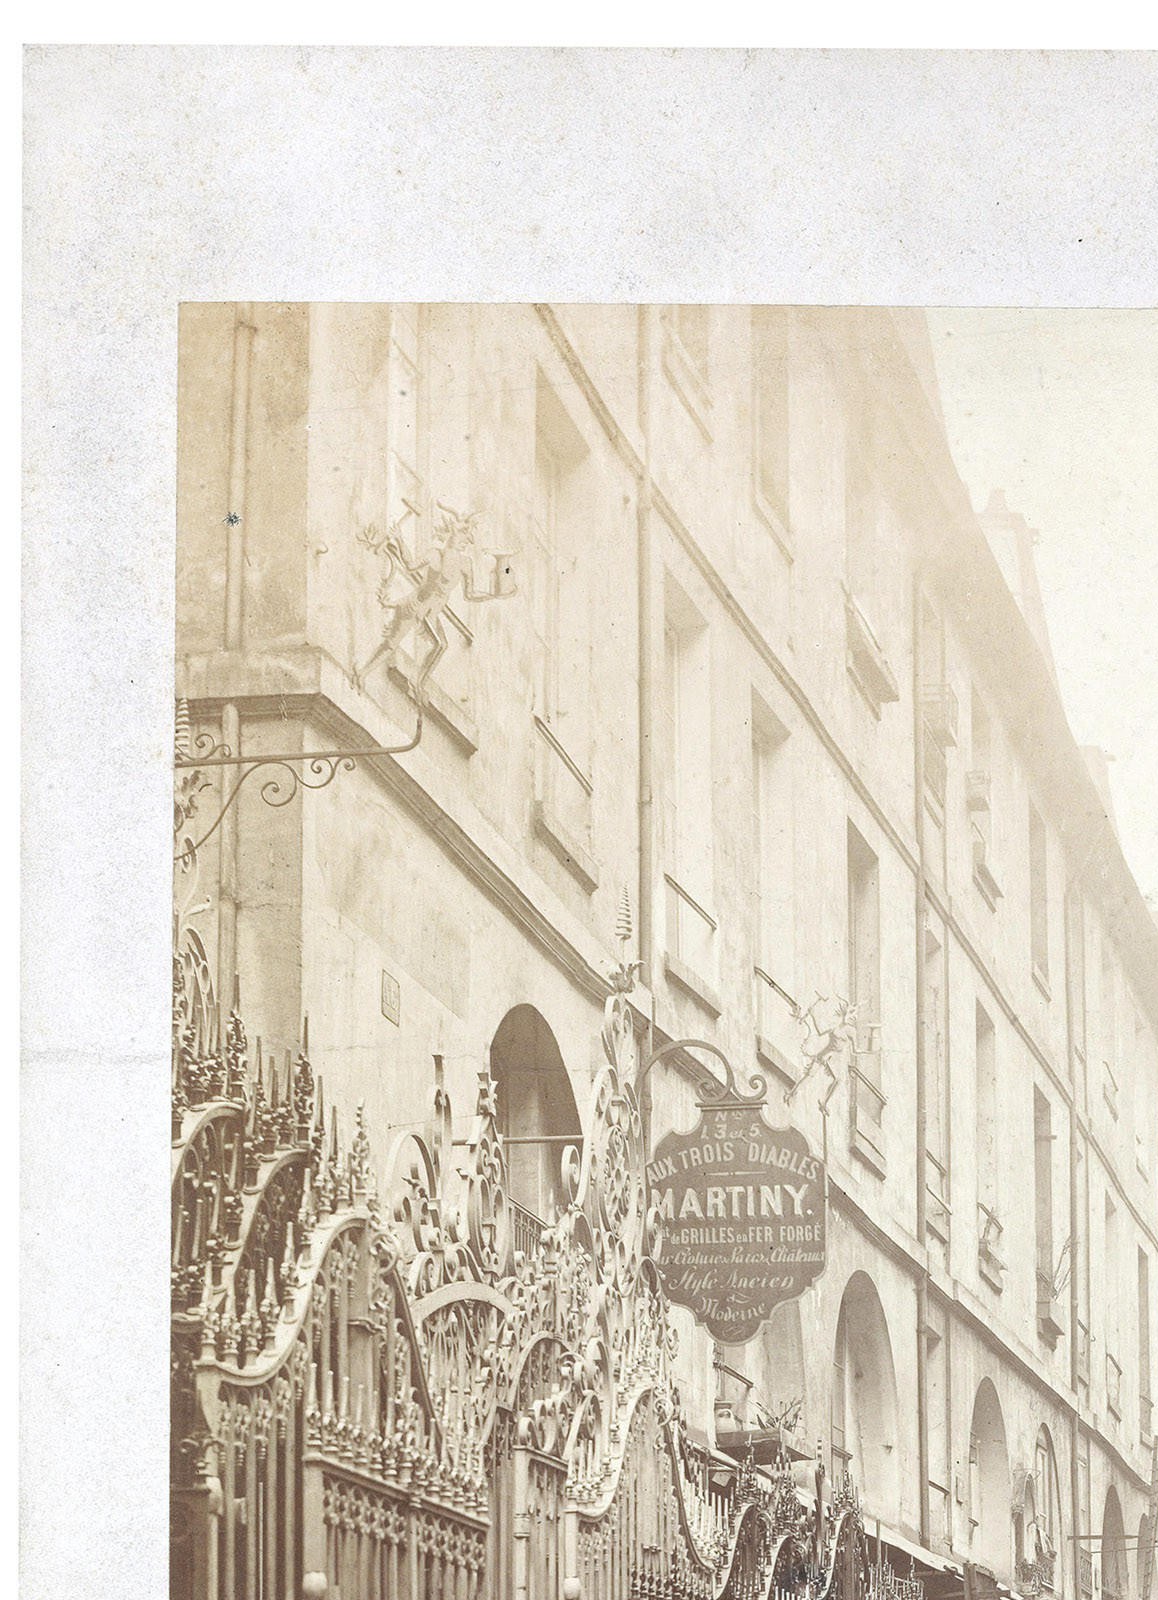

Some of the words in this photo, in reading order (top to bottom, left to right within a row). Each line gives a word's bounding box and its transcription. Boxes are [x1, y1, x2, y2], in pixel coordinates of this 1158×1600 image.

[714, 1124, 728, 1140] 3
[646, 1156, 678, 1186] AUX
[678, 1142, 735, 1170] TROIS
[650, 1184, 814, 1221] MARTINY.
[681, 1227, 735, 1245] GRILLES
[736, 1232, 748, 1243] en
[748, 1226, 774, 1243] FER
[780, 1222, 824, 1242] FORGÉ
[669, 1265, 718, 1297] Style
[720, 1269, 794, 1289] Ancien
[695, 1296, 767, 1322] Moderne
